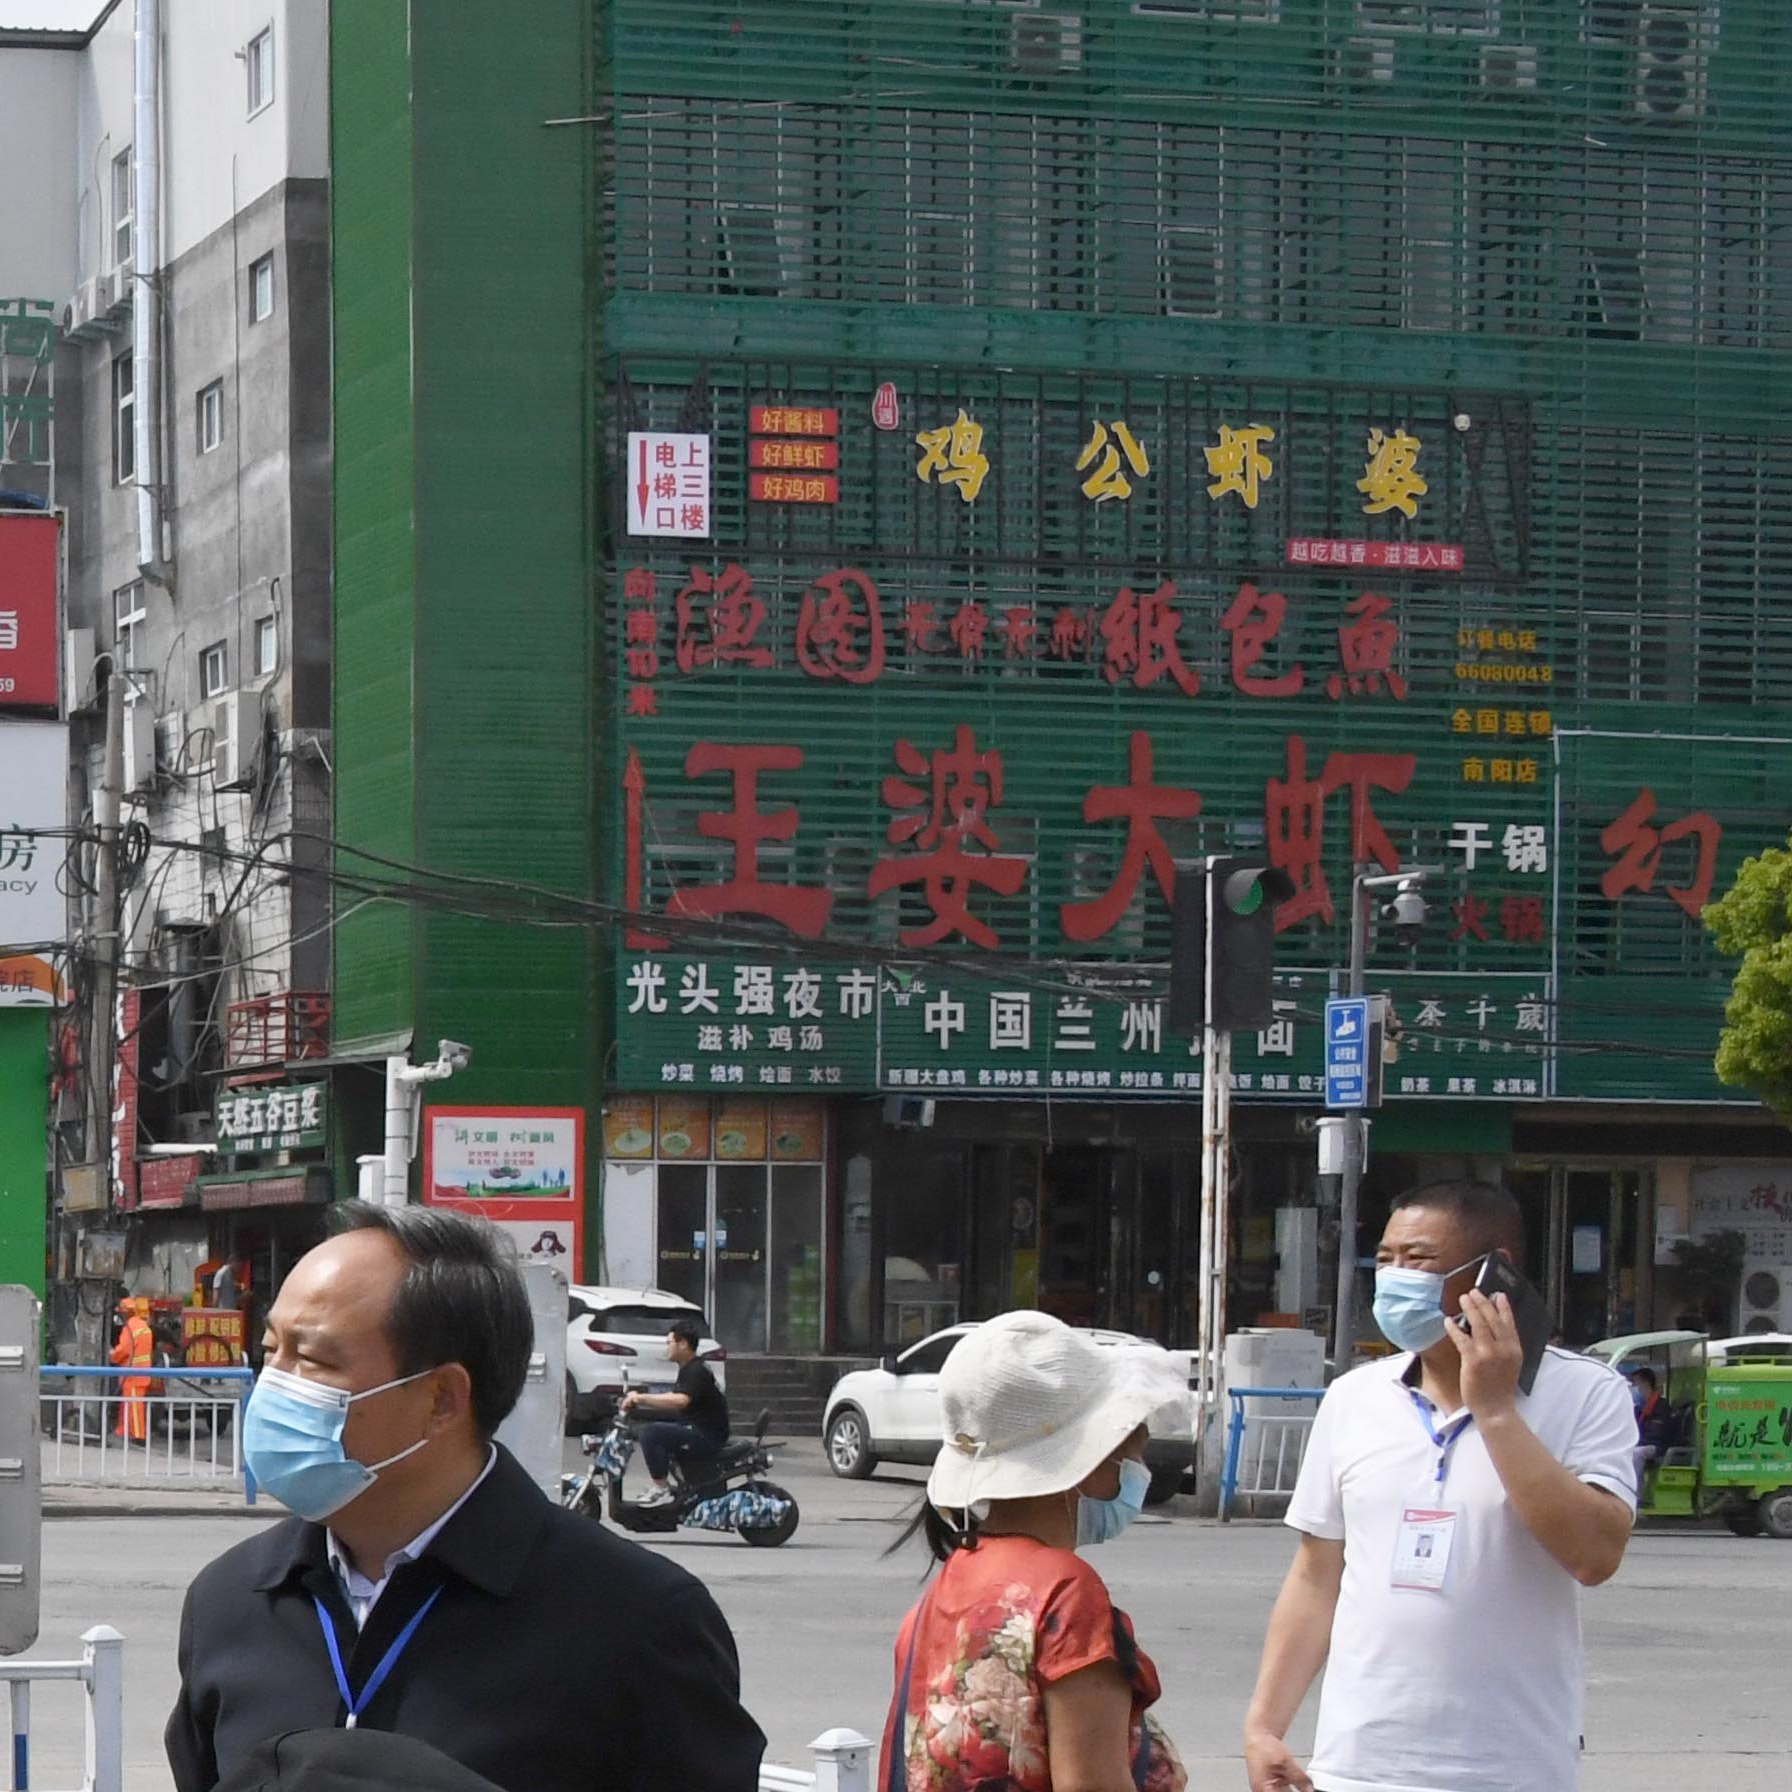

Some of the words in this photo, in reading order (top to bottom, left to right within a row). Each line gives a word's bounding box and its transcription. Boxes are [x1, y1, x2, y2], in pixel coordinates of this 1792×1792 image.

[761, 410, 824, 433] 好酱料
[761, 441, 825, 466] 好鲜虾
[917, 408, 1428, 519] 鸡公虾婆
[654, 441, 677, 530] 电梯口
[680, 441, 705, 531] 上三楼
[761, 476, 826, 501] 好鸡肉
[666, 723, 1417, 949] 王婆大虾
[1447, 821, 1548, 873] 干锅
[626, 960, 876, 1019] 光头强夜市
[767, 1025, 824, 1052] 鸡汤
[925, 990, 1294, 1057] 中国兰州面
